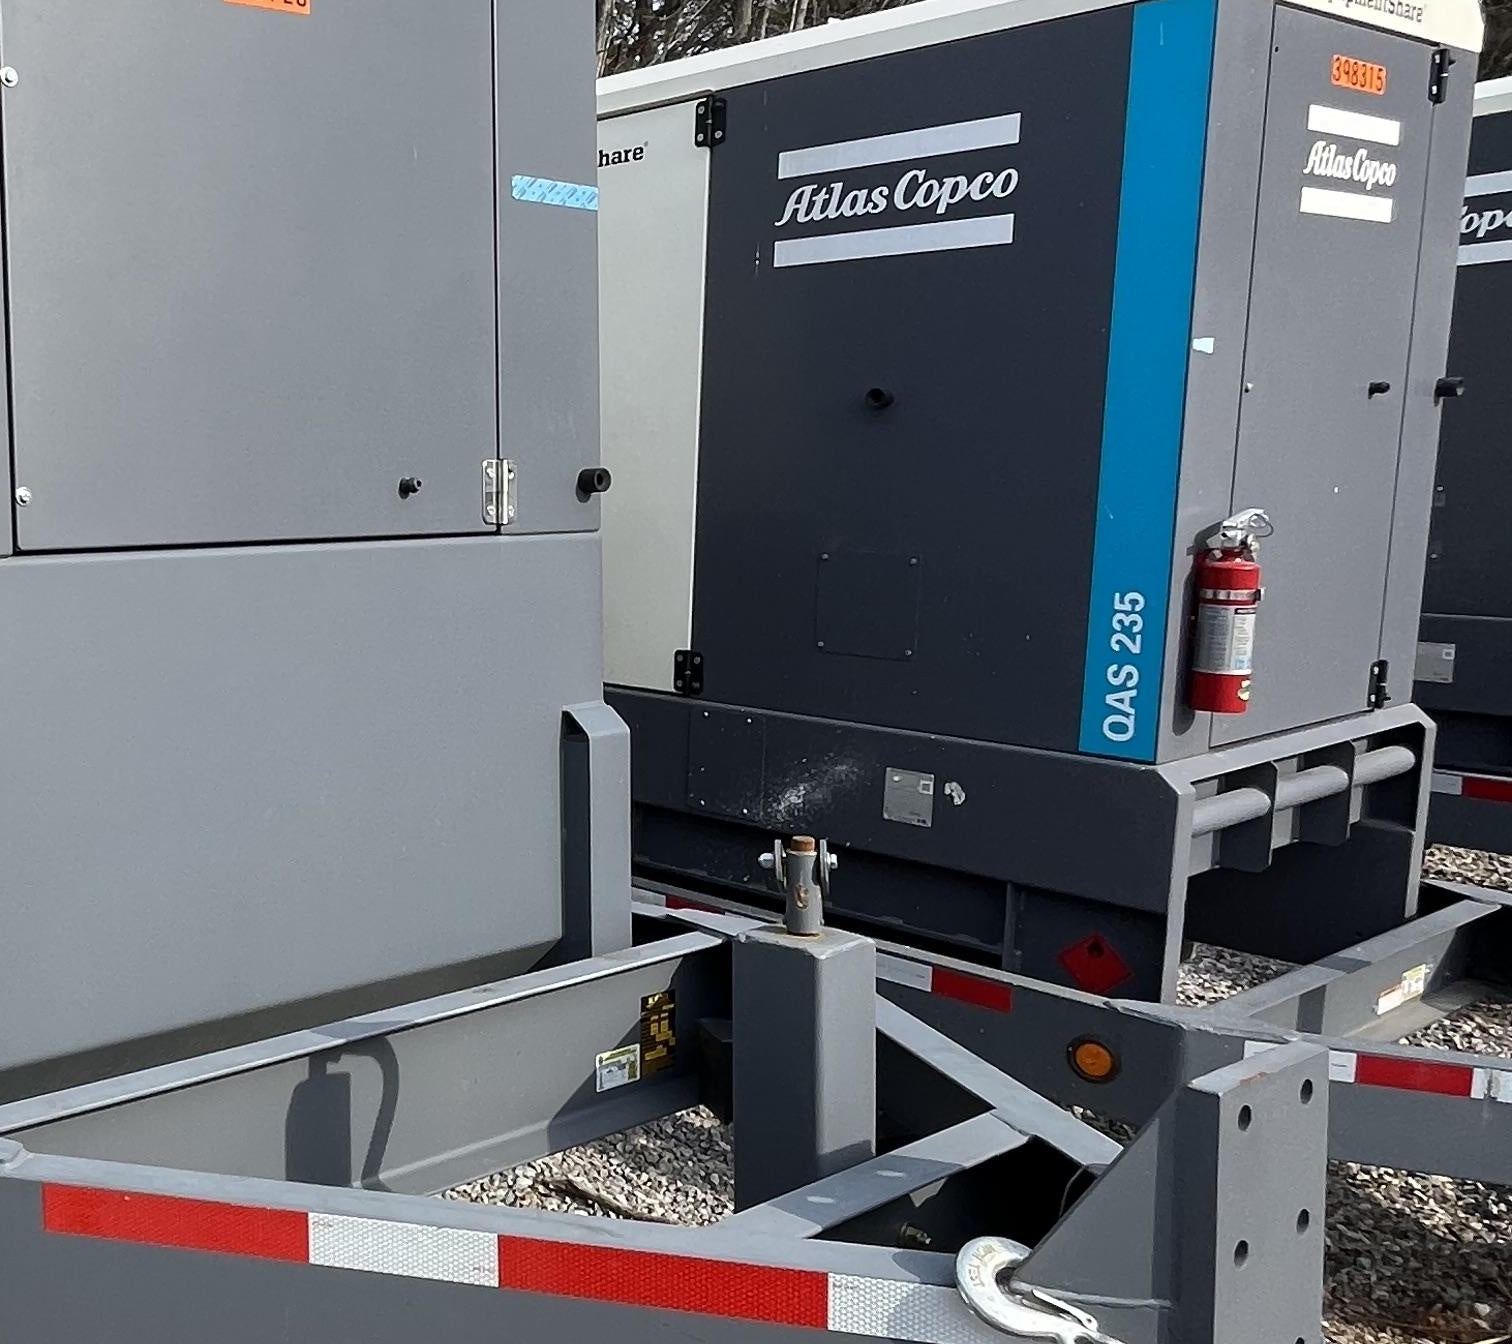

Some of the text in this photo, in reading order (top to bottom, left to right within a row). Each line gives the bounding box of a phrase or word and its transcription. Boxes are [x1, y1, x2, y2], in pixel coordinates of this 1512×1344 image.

[1332, 56, 1385, 93] 398315
[597, 145, 645, 168] hare
[1302, 140, 1398, 191] Atlas Copco
[773, 167, 1020, 227] Atlas Copco
[1102, 590, 1146, 743] QAS 235
